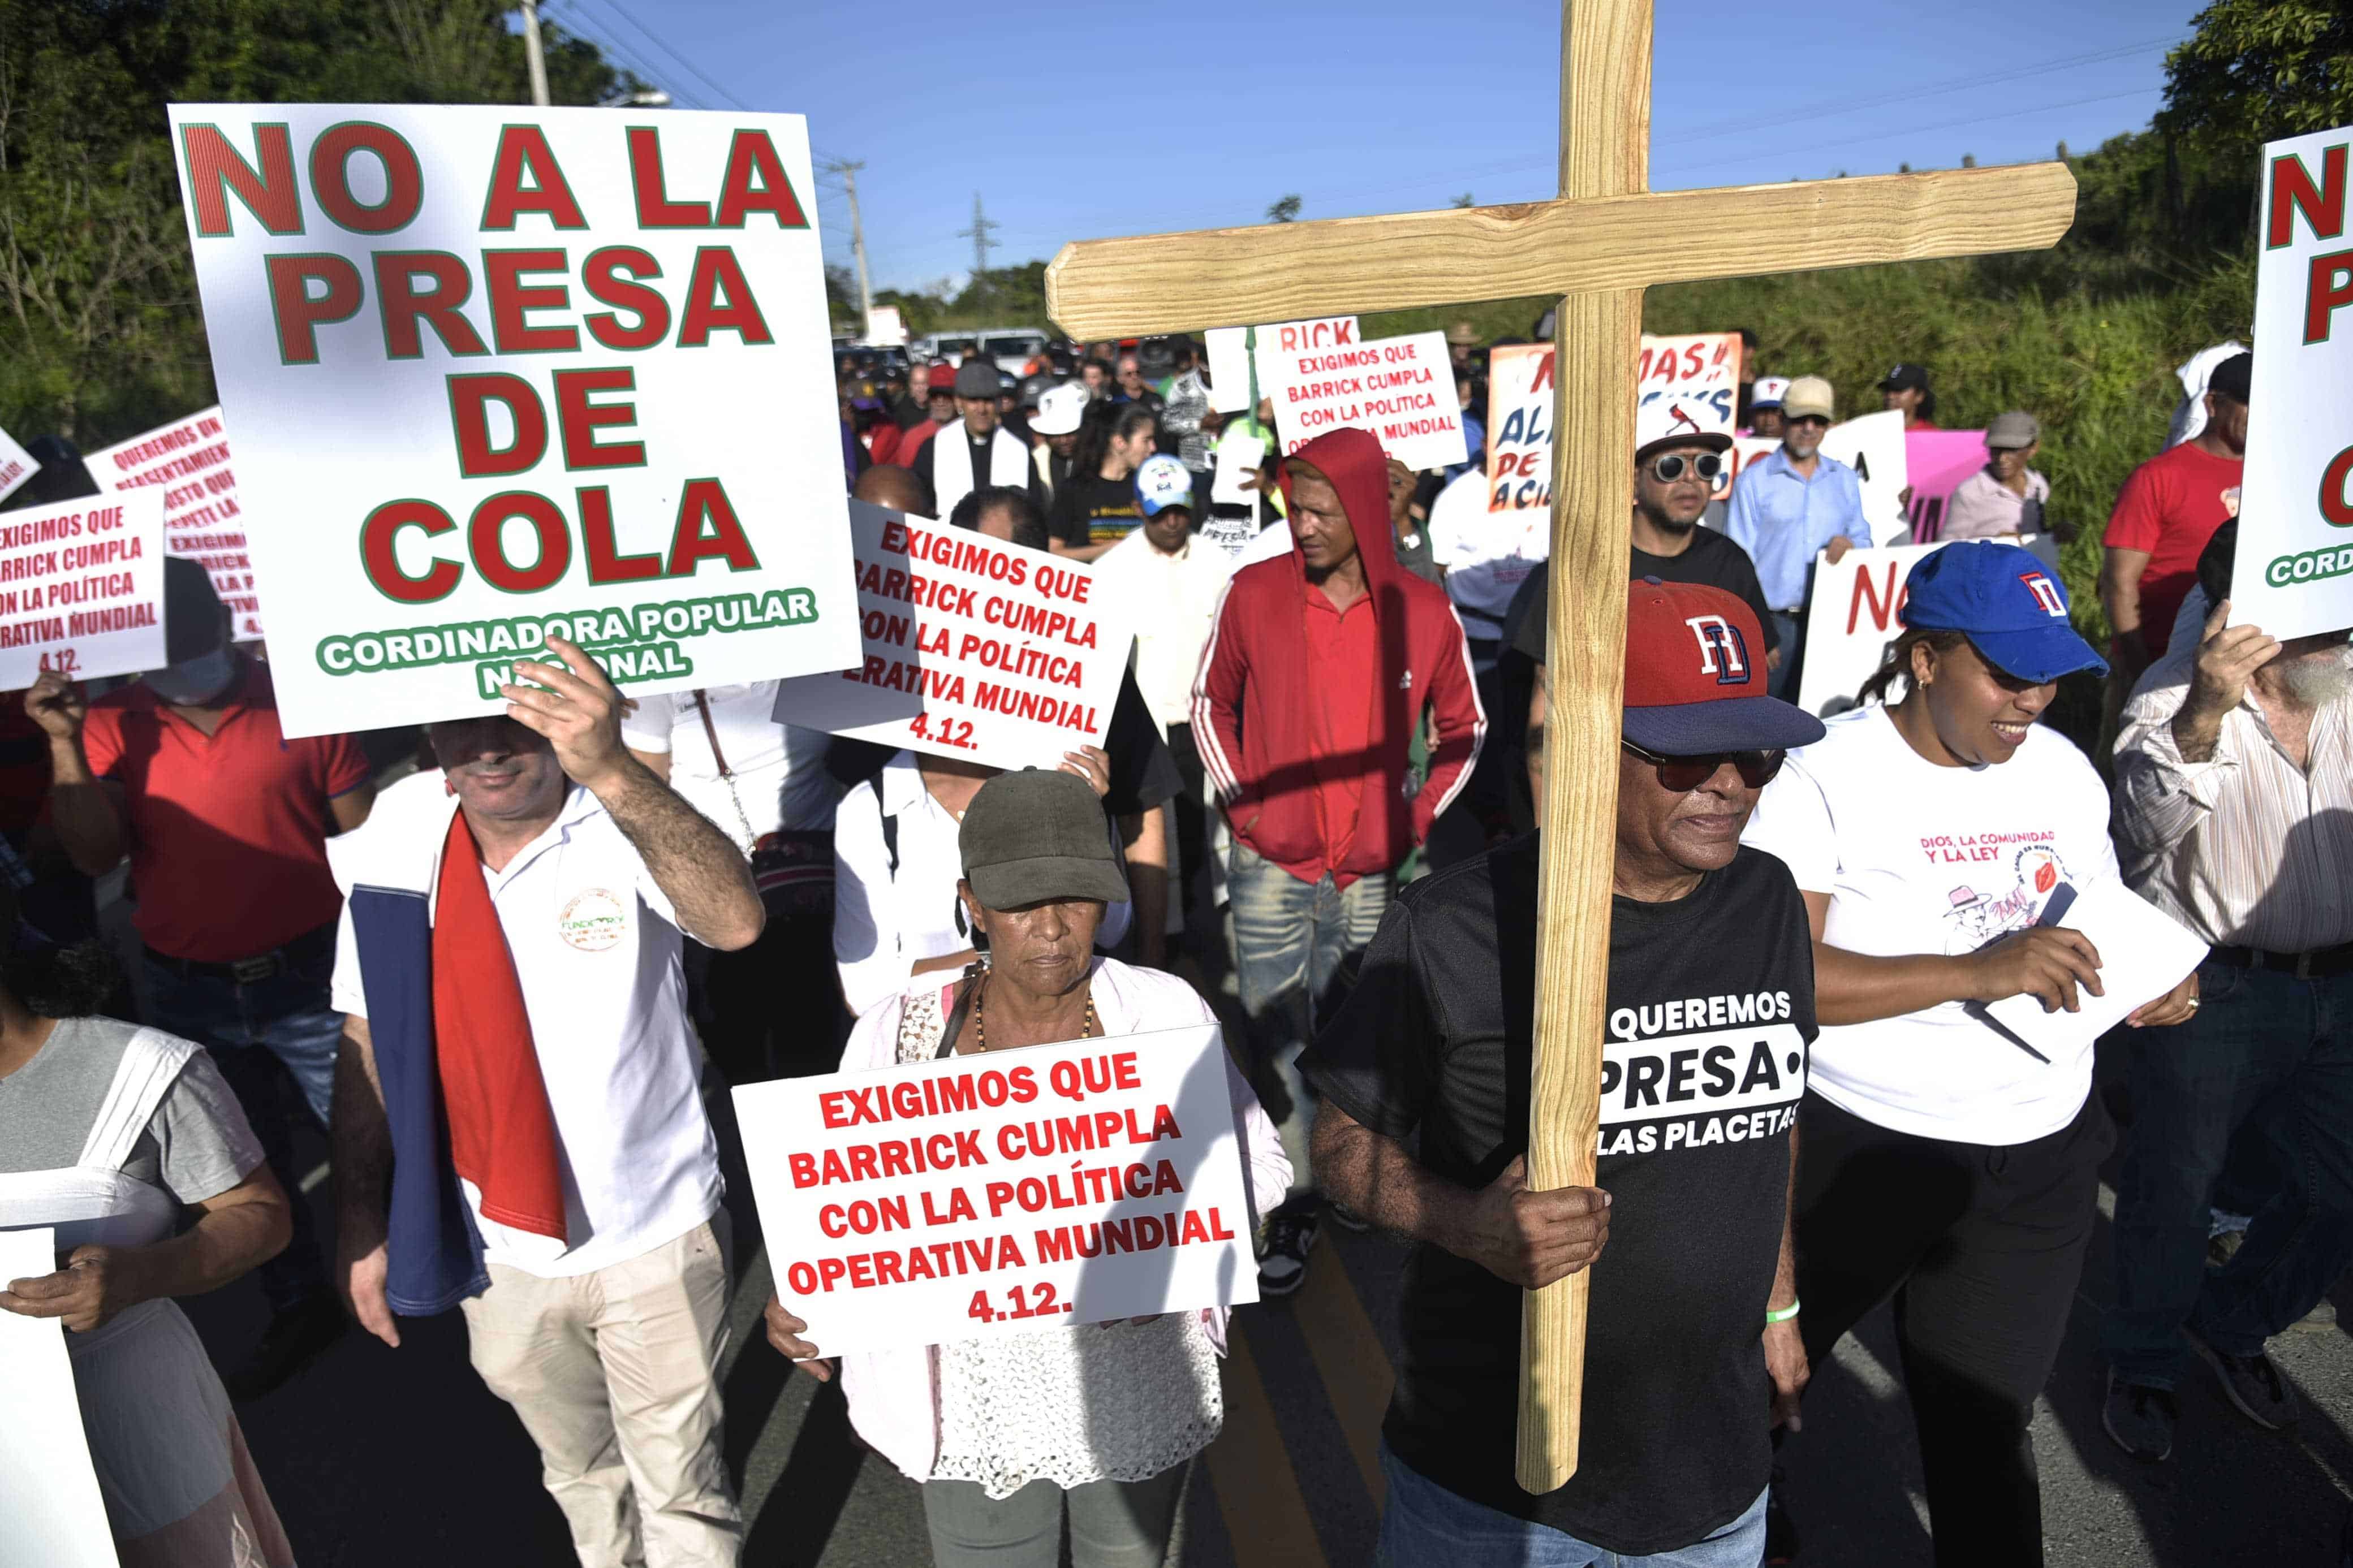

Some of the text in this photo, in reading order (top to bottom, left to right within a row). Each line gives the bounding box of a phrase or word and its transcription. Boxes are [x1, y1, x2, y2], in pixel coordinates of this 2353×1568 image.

[179, 120, 811, 238] NO A LA
[264, 245, 775, 366] PRESA
[1299, 344, 1416, 374] EXIGIMOS QUE
[1287, 368, 1433, 403] BARRICK CUMPLA
[445, 366, 648, 480] DE
[1300, 408, 1335, 427] CON
[1340, 404, 1360, 421] LA
[1384, 416, 1456, 439] MUNDIAL
[113, 425, 197, 471] QUEREMOS
[1497, 452, 1541, 480] DE
[0, 506, 123, 550] XIGIMOS QUE
[359, 477, 762, 605] COLA
[63, 537, 142, 571] CUMPLA
[881, 521, 1092, 603] EXIGIMOS QUE
[2271, 548, 2353, 583] CORD
[22, 587, 43, 612] LA
[48, 572, 134, 606] POLÍTICA
[0, 602, 157, 649] RATIVA MUNDIAL
[323, 593, 813, 667] CORDINADORA POPULAR
[984, 596, 1097, 650] CUMPLA
[39, 648, 81, 673] 412.
[859, 606, 1083, 689] ON LA POLÍTICA
[973, 681, 1098, 734] MUNDIAL
[910, 712, 978, 750] 4.12.
[1921, 831, 2054, 848] DIOS, LA COMUNIDAD
[1925, 846, 1998, 864] Y LA LEY
[1610, 991, 1791, 1042] QUEREMOS
[819, 1051, 1141, 1130] EXIGIMOS QUE
[788, 1104, 1182, 1189] BARRICK CUMPLA
[1597, 1125, 1657, 1156] LAS
[819, 1159, 1184, 1239] CON LA POLÍTICA
[788, 1206, 1235, 1295] OPERATIVA MUNDIAL
[968, 1281, 1074, 1324] 4.12.
